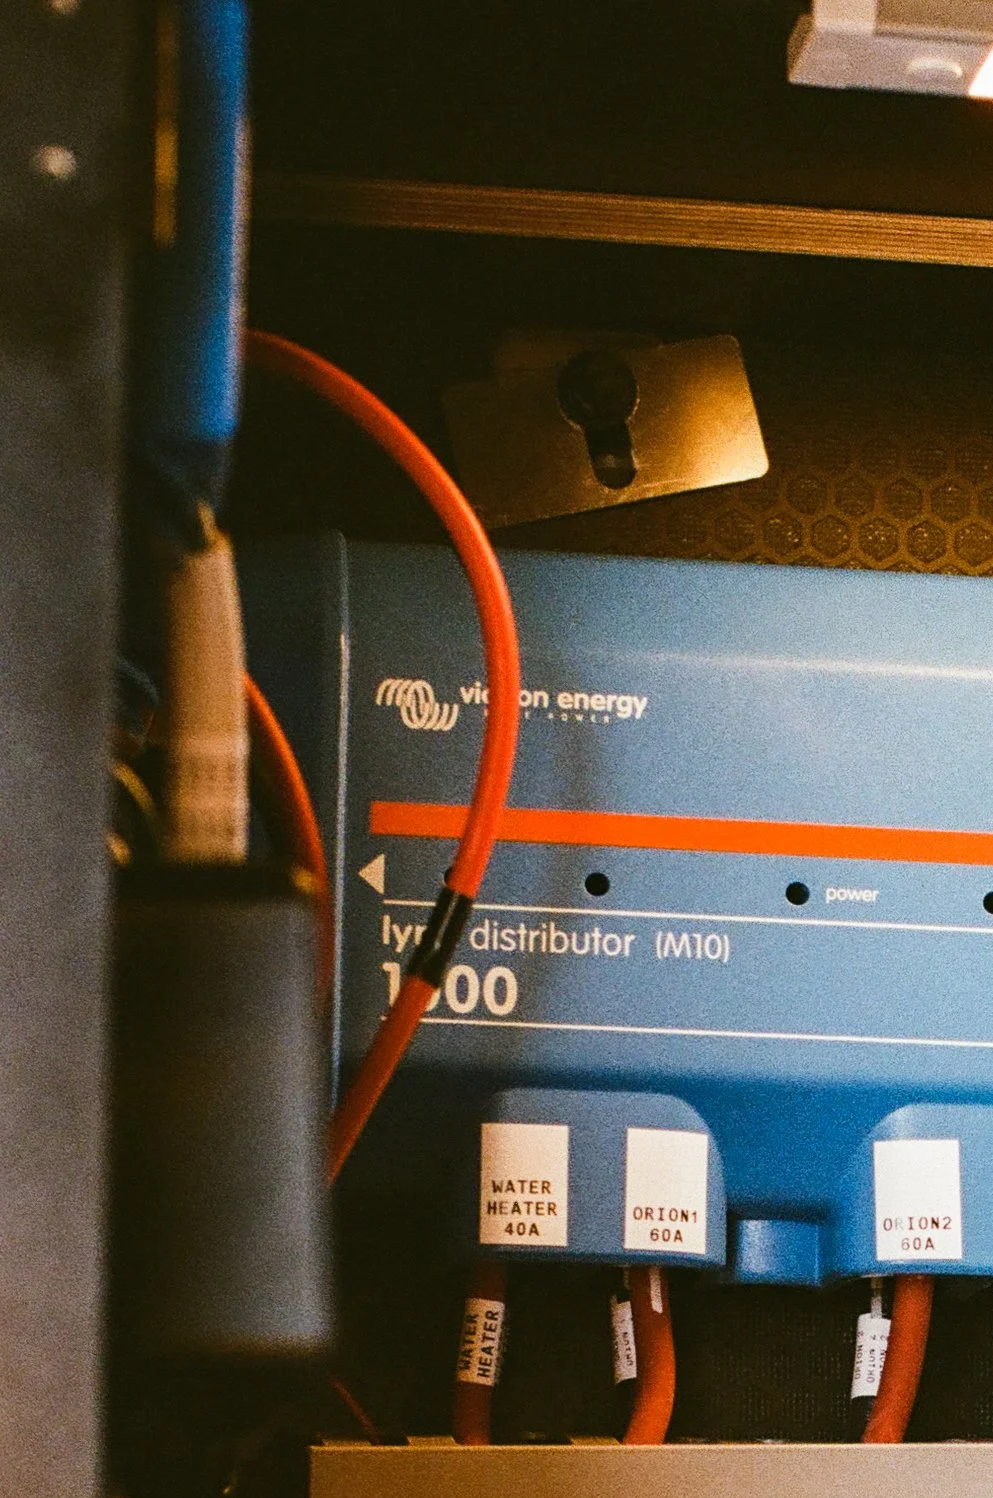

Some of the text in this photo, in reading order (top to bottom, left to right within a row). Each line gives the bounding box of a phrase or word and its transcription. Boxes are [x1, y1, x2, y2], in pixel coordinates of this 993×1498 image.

[557, 690, 648, 720] energy
[824, 885, 880, 905] power
[469, 918, 731, 963] distributor (M10)
[380, 961, 518, 1017] 100
[491, 1179, 552, 1195] WATER
[486, 1200, 558, 1216] HEATER
[632, 1206, 699, 1224] ORION1
[504, 1221, 540, 1236] 40A
[882, 1216, 953, 1232] ORION2
[650, 1228, 683, 1243] 60A
[900, 1237, 936, 1251] 60A
[459, 1313, 479, 1371] WATER
[477, 1309, 500, 1379] HEATER
